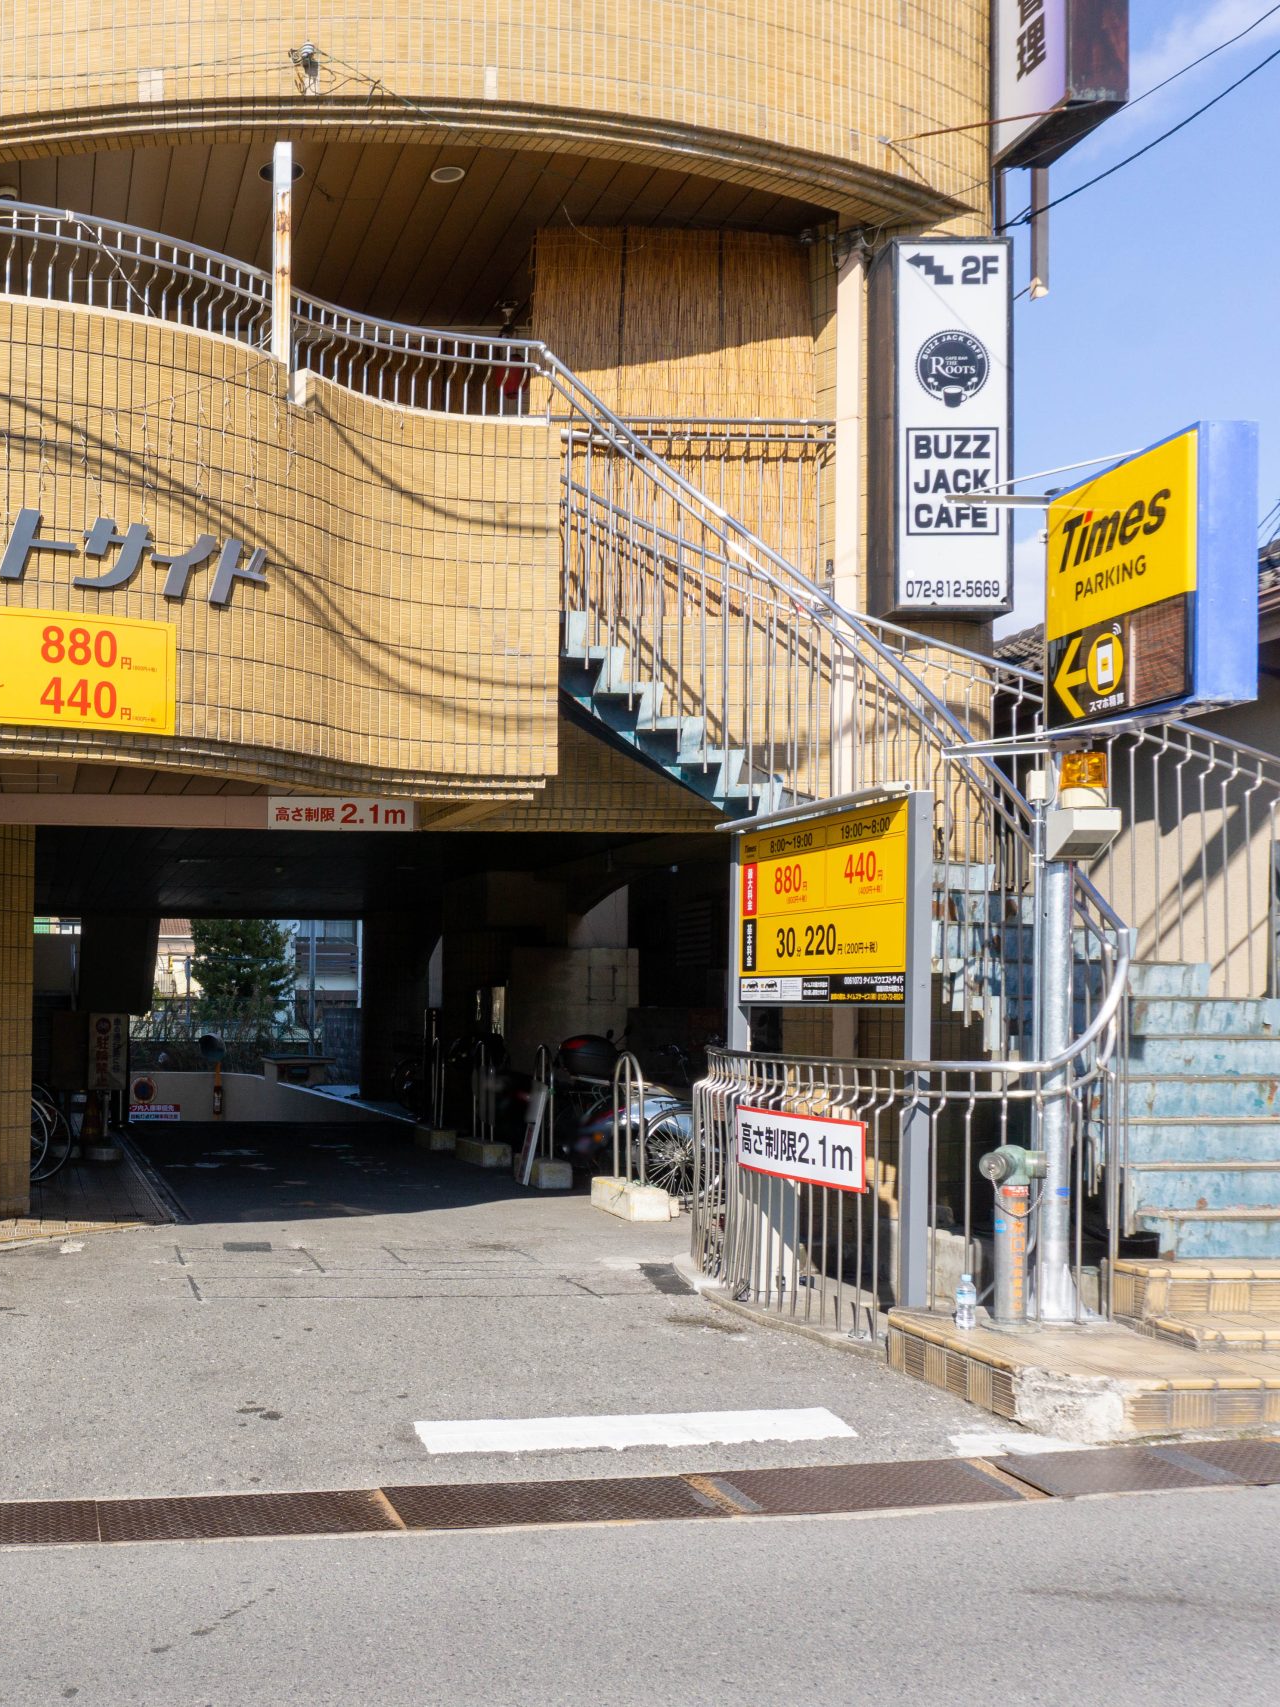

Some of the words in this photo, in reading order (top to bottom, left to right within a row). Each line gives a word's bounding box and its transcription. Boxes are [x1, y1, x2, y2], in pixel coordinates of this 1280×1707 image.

[962, 255, 999, 285] 2F
[922, 339, 940, 360] BUZZ
[941, 334, 965, 343] JACK
[966, 339, 984, 360] CAFE
[913, 434, 991, 459] BUZZ
[913, 468, 992, 495] JACK
[913, 500, 988, 529] CAFE
[1058, 487, 1172, 574] Times
[905, 580, 1000, 599] 072-812-5669
[1074, 555, 1147, 602] PARKING
[275, 806, 335, 823] 高さ制限
[340, 803, 406, 825] 2.1m
[741, 1121, 854, 1172] 高さ制限2.1m
